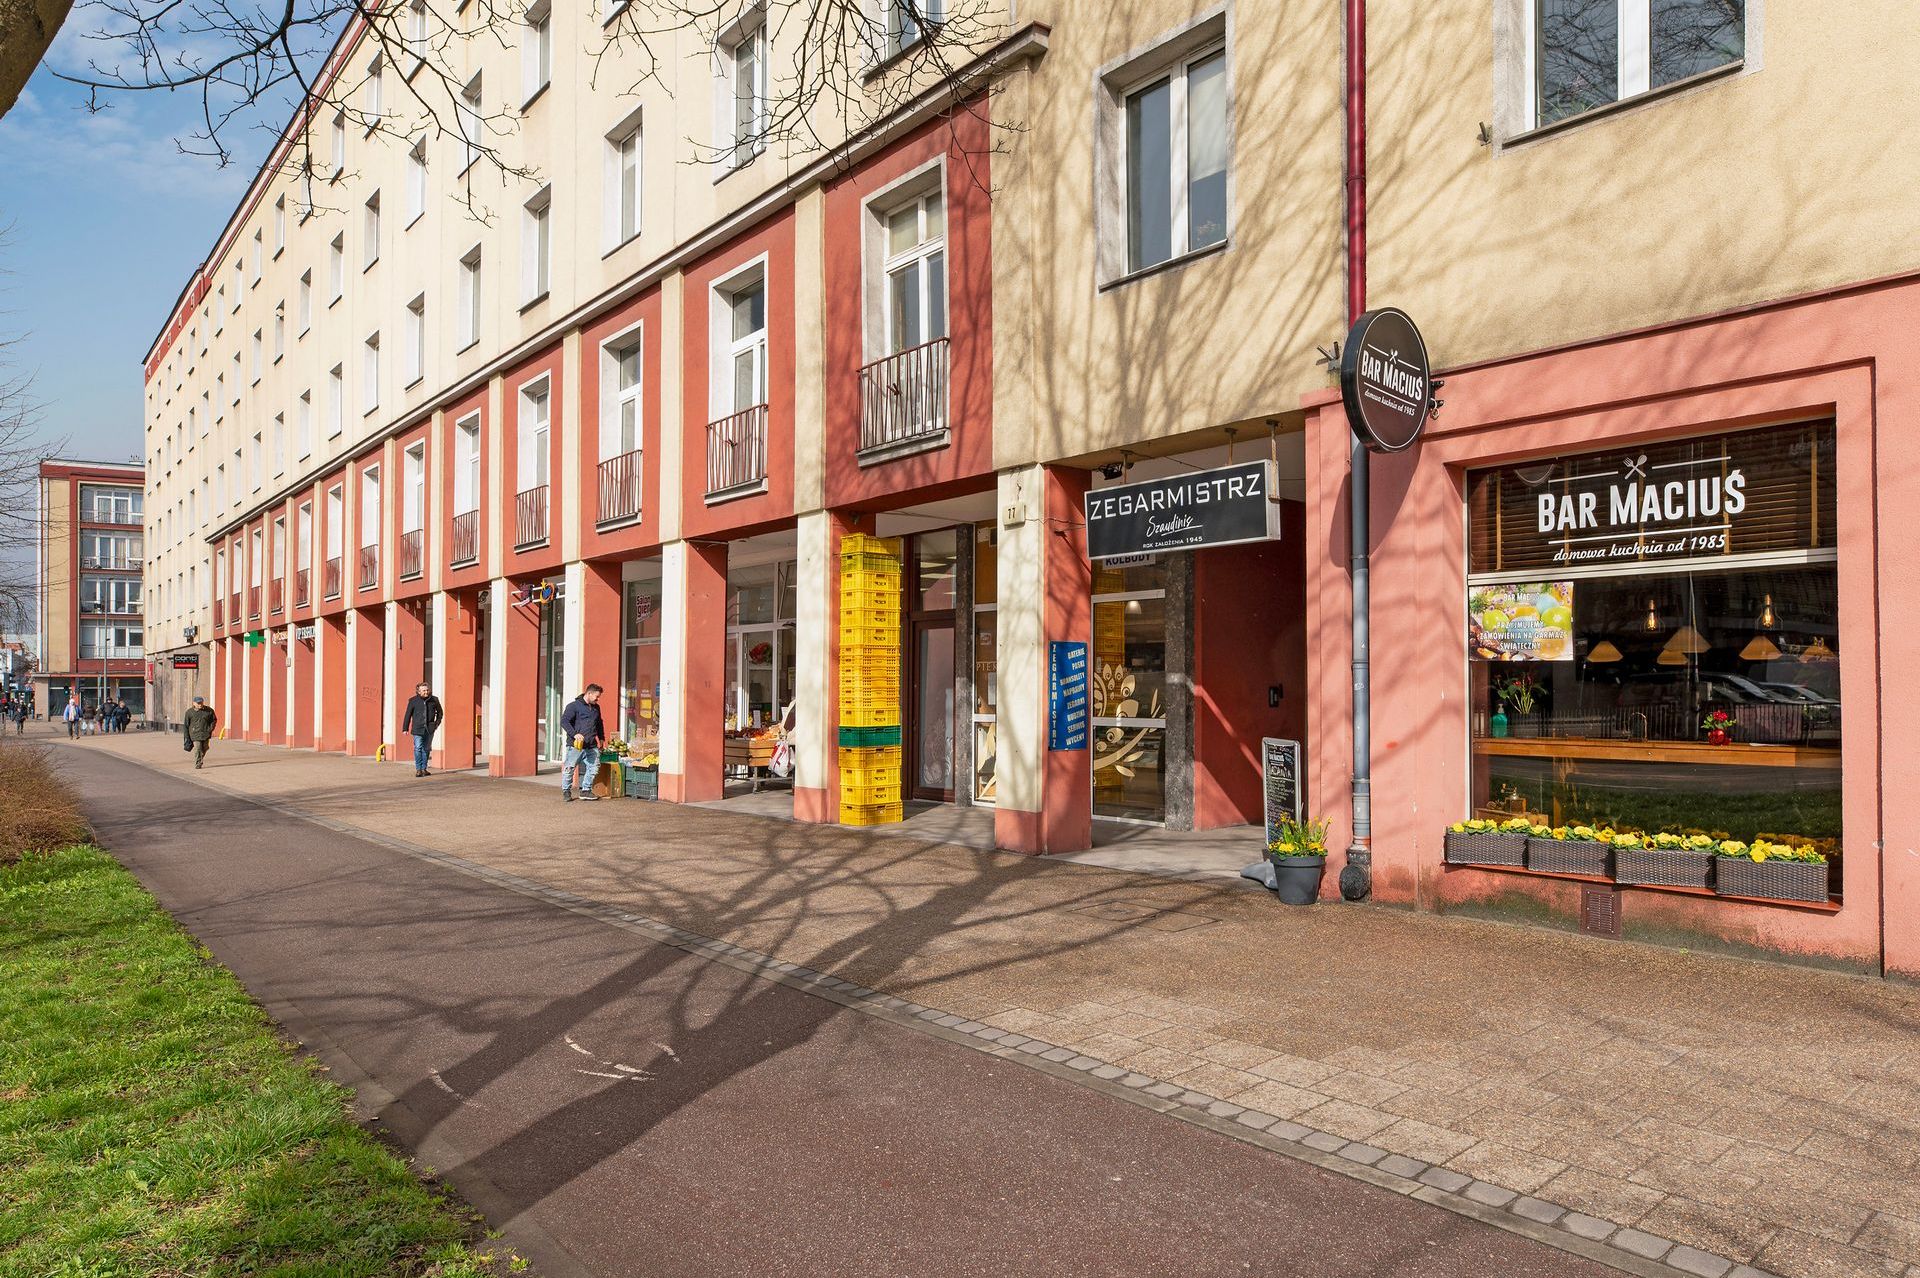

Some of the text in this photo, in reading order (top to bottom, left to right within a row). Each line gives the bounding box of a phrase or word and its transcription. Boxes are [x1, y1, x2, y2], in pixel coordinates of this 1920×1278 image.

[1361, 350, 1423, 400] BAR MACIUŚ
[1364, 388, 1382, 403] domowa
[1381, 395, 1398, 409] kuchnia
[1403, 406, 1416, 416] 1985
[1090, 473, 1261, 521] ZEGARMISTRZ
[1538, 469, 1746, 533] BAR MACIUŚ
[1154, 538, 1184, 548] ZAŁOŻENIA
[1186, 535, 1203, 544] 1945
[1553, 534, 1726, 562] domowa kuchnia od 1985
[1503, 592, 1516, 602] BAR
